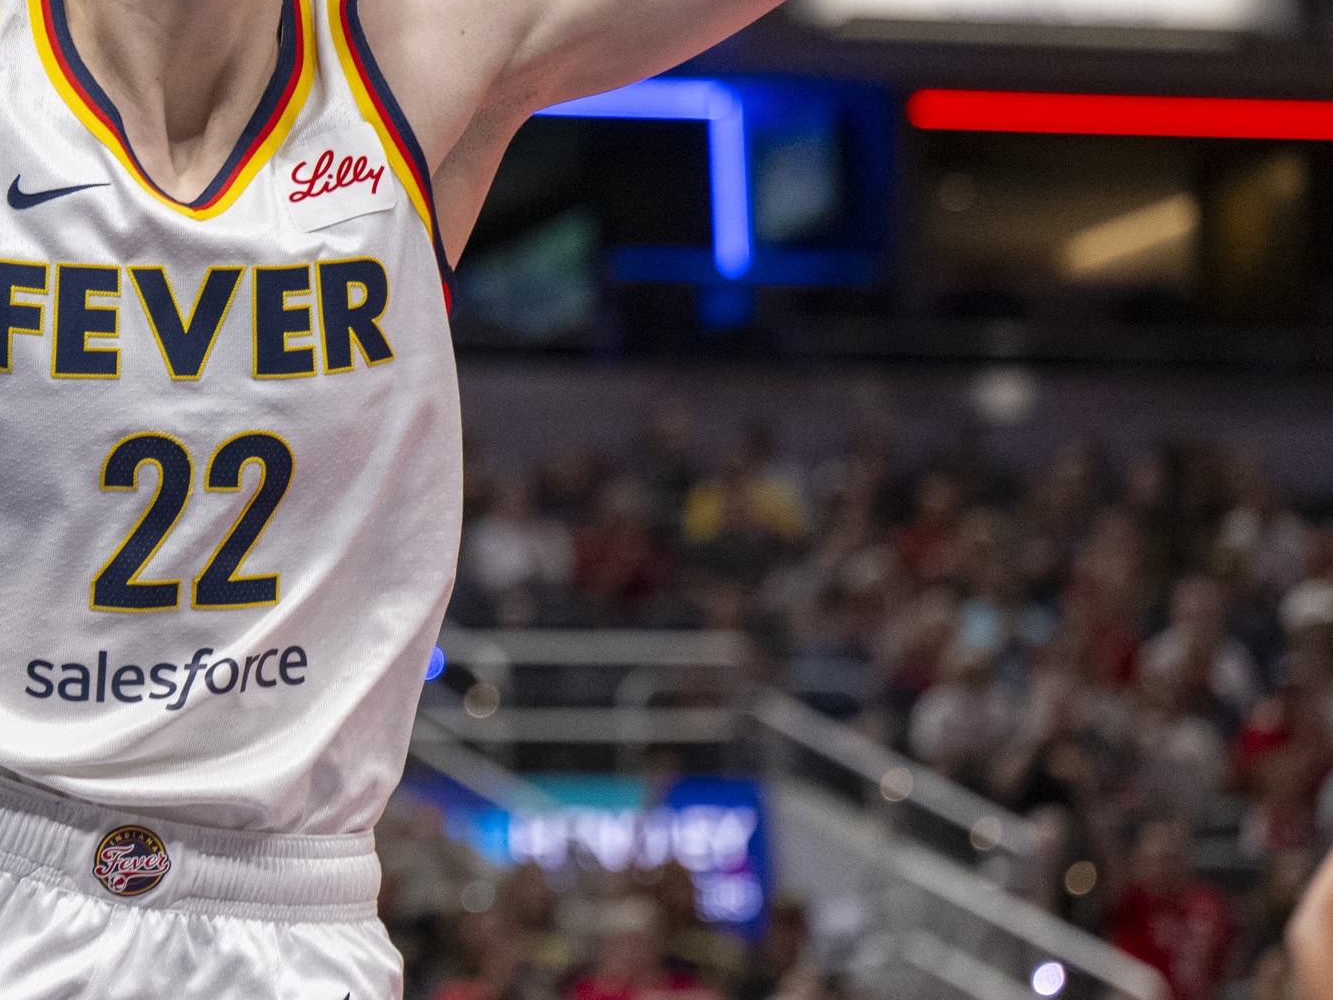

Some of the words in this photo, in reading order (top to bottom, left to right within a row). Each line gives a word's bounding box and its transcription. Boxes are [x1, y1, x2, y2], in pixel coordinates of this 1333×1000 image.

[289, 150, 385, 203] Lilly
[90, 431, 295, 612] 22
[25, 644, 308, 710] salesforce
[94, 843, 170, 878] Fever
[109, 831, 159, 853] INDIANA
